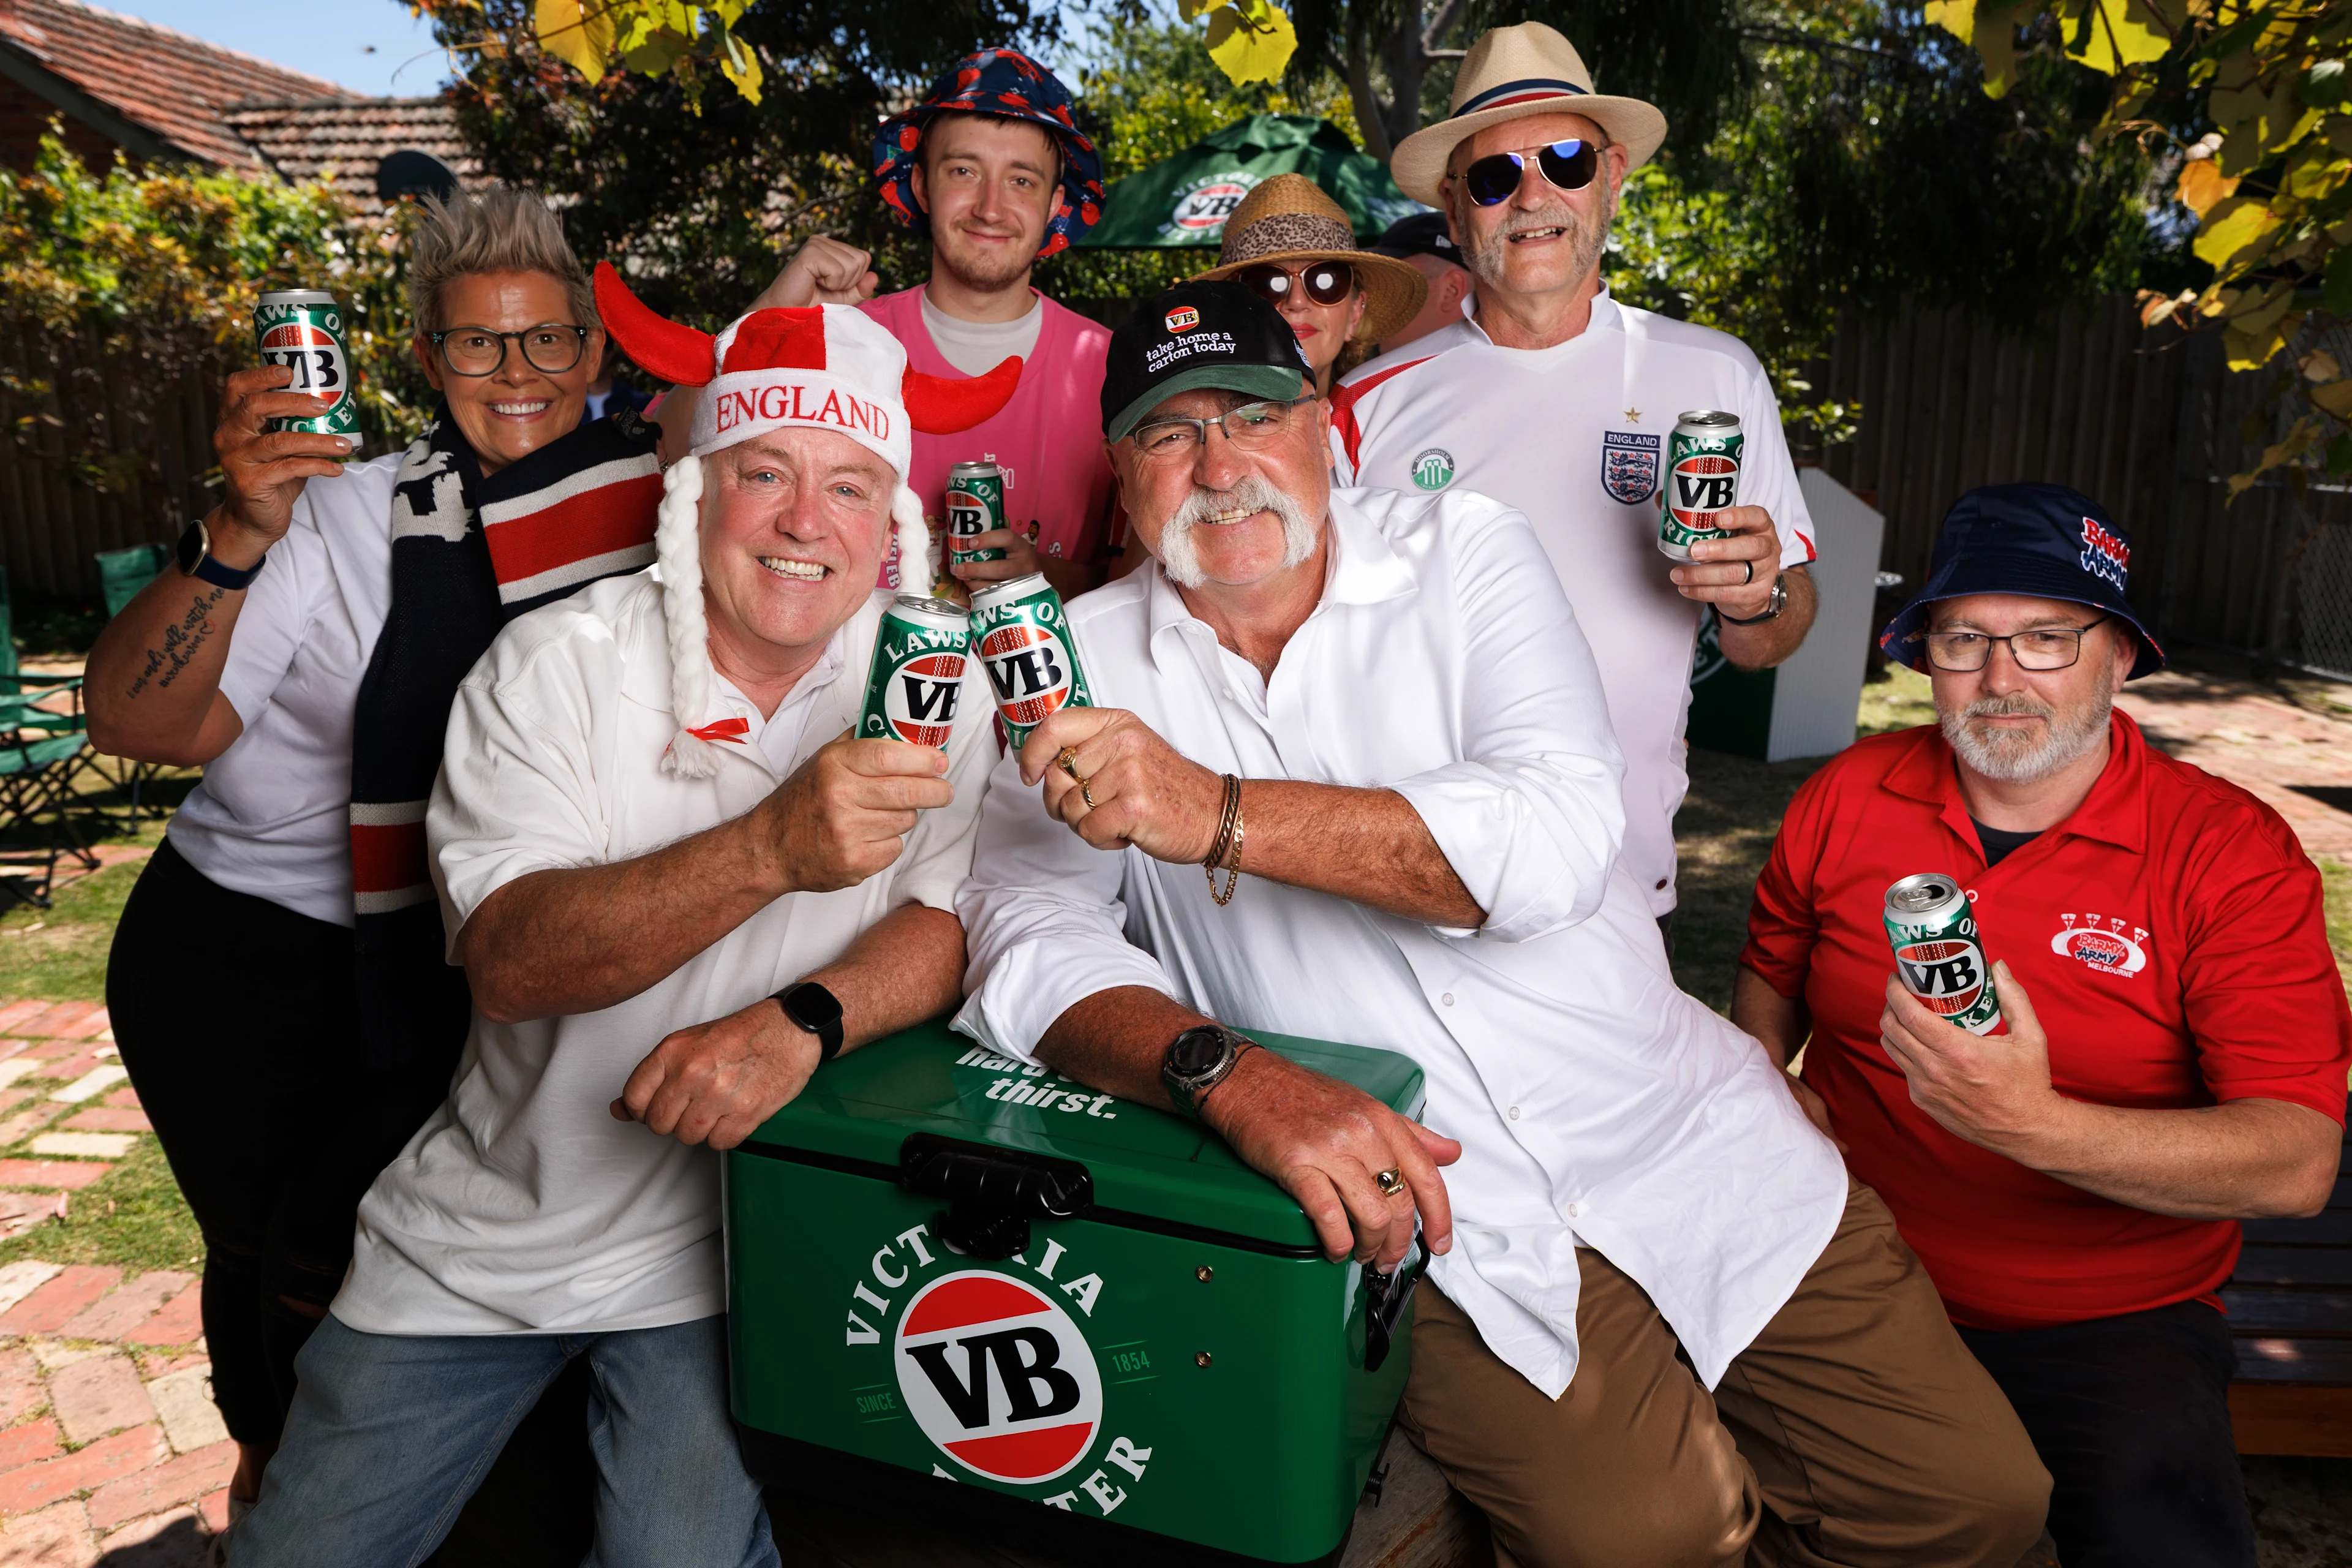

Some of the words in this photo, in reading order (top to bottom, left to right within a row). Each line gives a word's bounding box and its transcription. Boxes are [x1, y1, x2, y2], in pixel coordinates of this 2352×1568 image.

[1171, 171, 1264, 197] VICTORI
[1190, 197, 1239, 215] VB
[1156, 222, 1221, 242] BITTE
[255, 304, 309, 332] AWS
[1169, 312, 1197, 326] VB
[1145, 341, 1175, 362] take
[1175, 332, 1221, 347] home
[1223, 332, 1233, 341] a
[1148, 347, 1192, 373] carton
[1194, 339, 1237, 354] today
[262, 350, 339, 390] VB
[278, 391, 356, 434] ICKET
[716, 385, 889, 441] ENGLAND
[1607, 434, 1657, 447] ENGLAND
[1668, 437, 1727, 464] LAWS
[1735, 443, 1743, 459] O
[1415, 449, 1451, 464] MOORSHOLM
[977, 483, 998, 503] OF
[1675, 473, 1735, 509] VB
[949, 510, 984, 535] VB
[970, 601, 1017, 635] AWS
[1036, 601, 1066, 631] OF
[145, 649, 162, 678] and
[184, 596, 213, 630] watch
[883, 630, 968, 664] LAWS
[983, 647, 1063, 701] VB
[902, 674, 963, 722] VB
[1887, 922, 1943, 945] AWS
[1958, 918, 1978, 938] OF
[2076, 933, 2125, 954] BARMY
[2075, 946, 2118, 965] ARMY
[1899, 956, 1978, 995] VB
[2087, 962, 2135, 979] MELBOURNE
[985, 1078, 1117, 1120] thirst.
[846, 1224, 1104, 1346] VICTIA
[1112, 1351, 1151, 1373] 1854
[905, 1326, 1080, 1430] VB
[856, 1393, 897, 1414] SINCE
